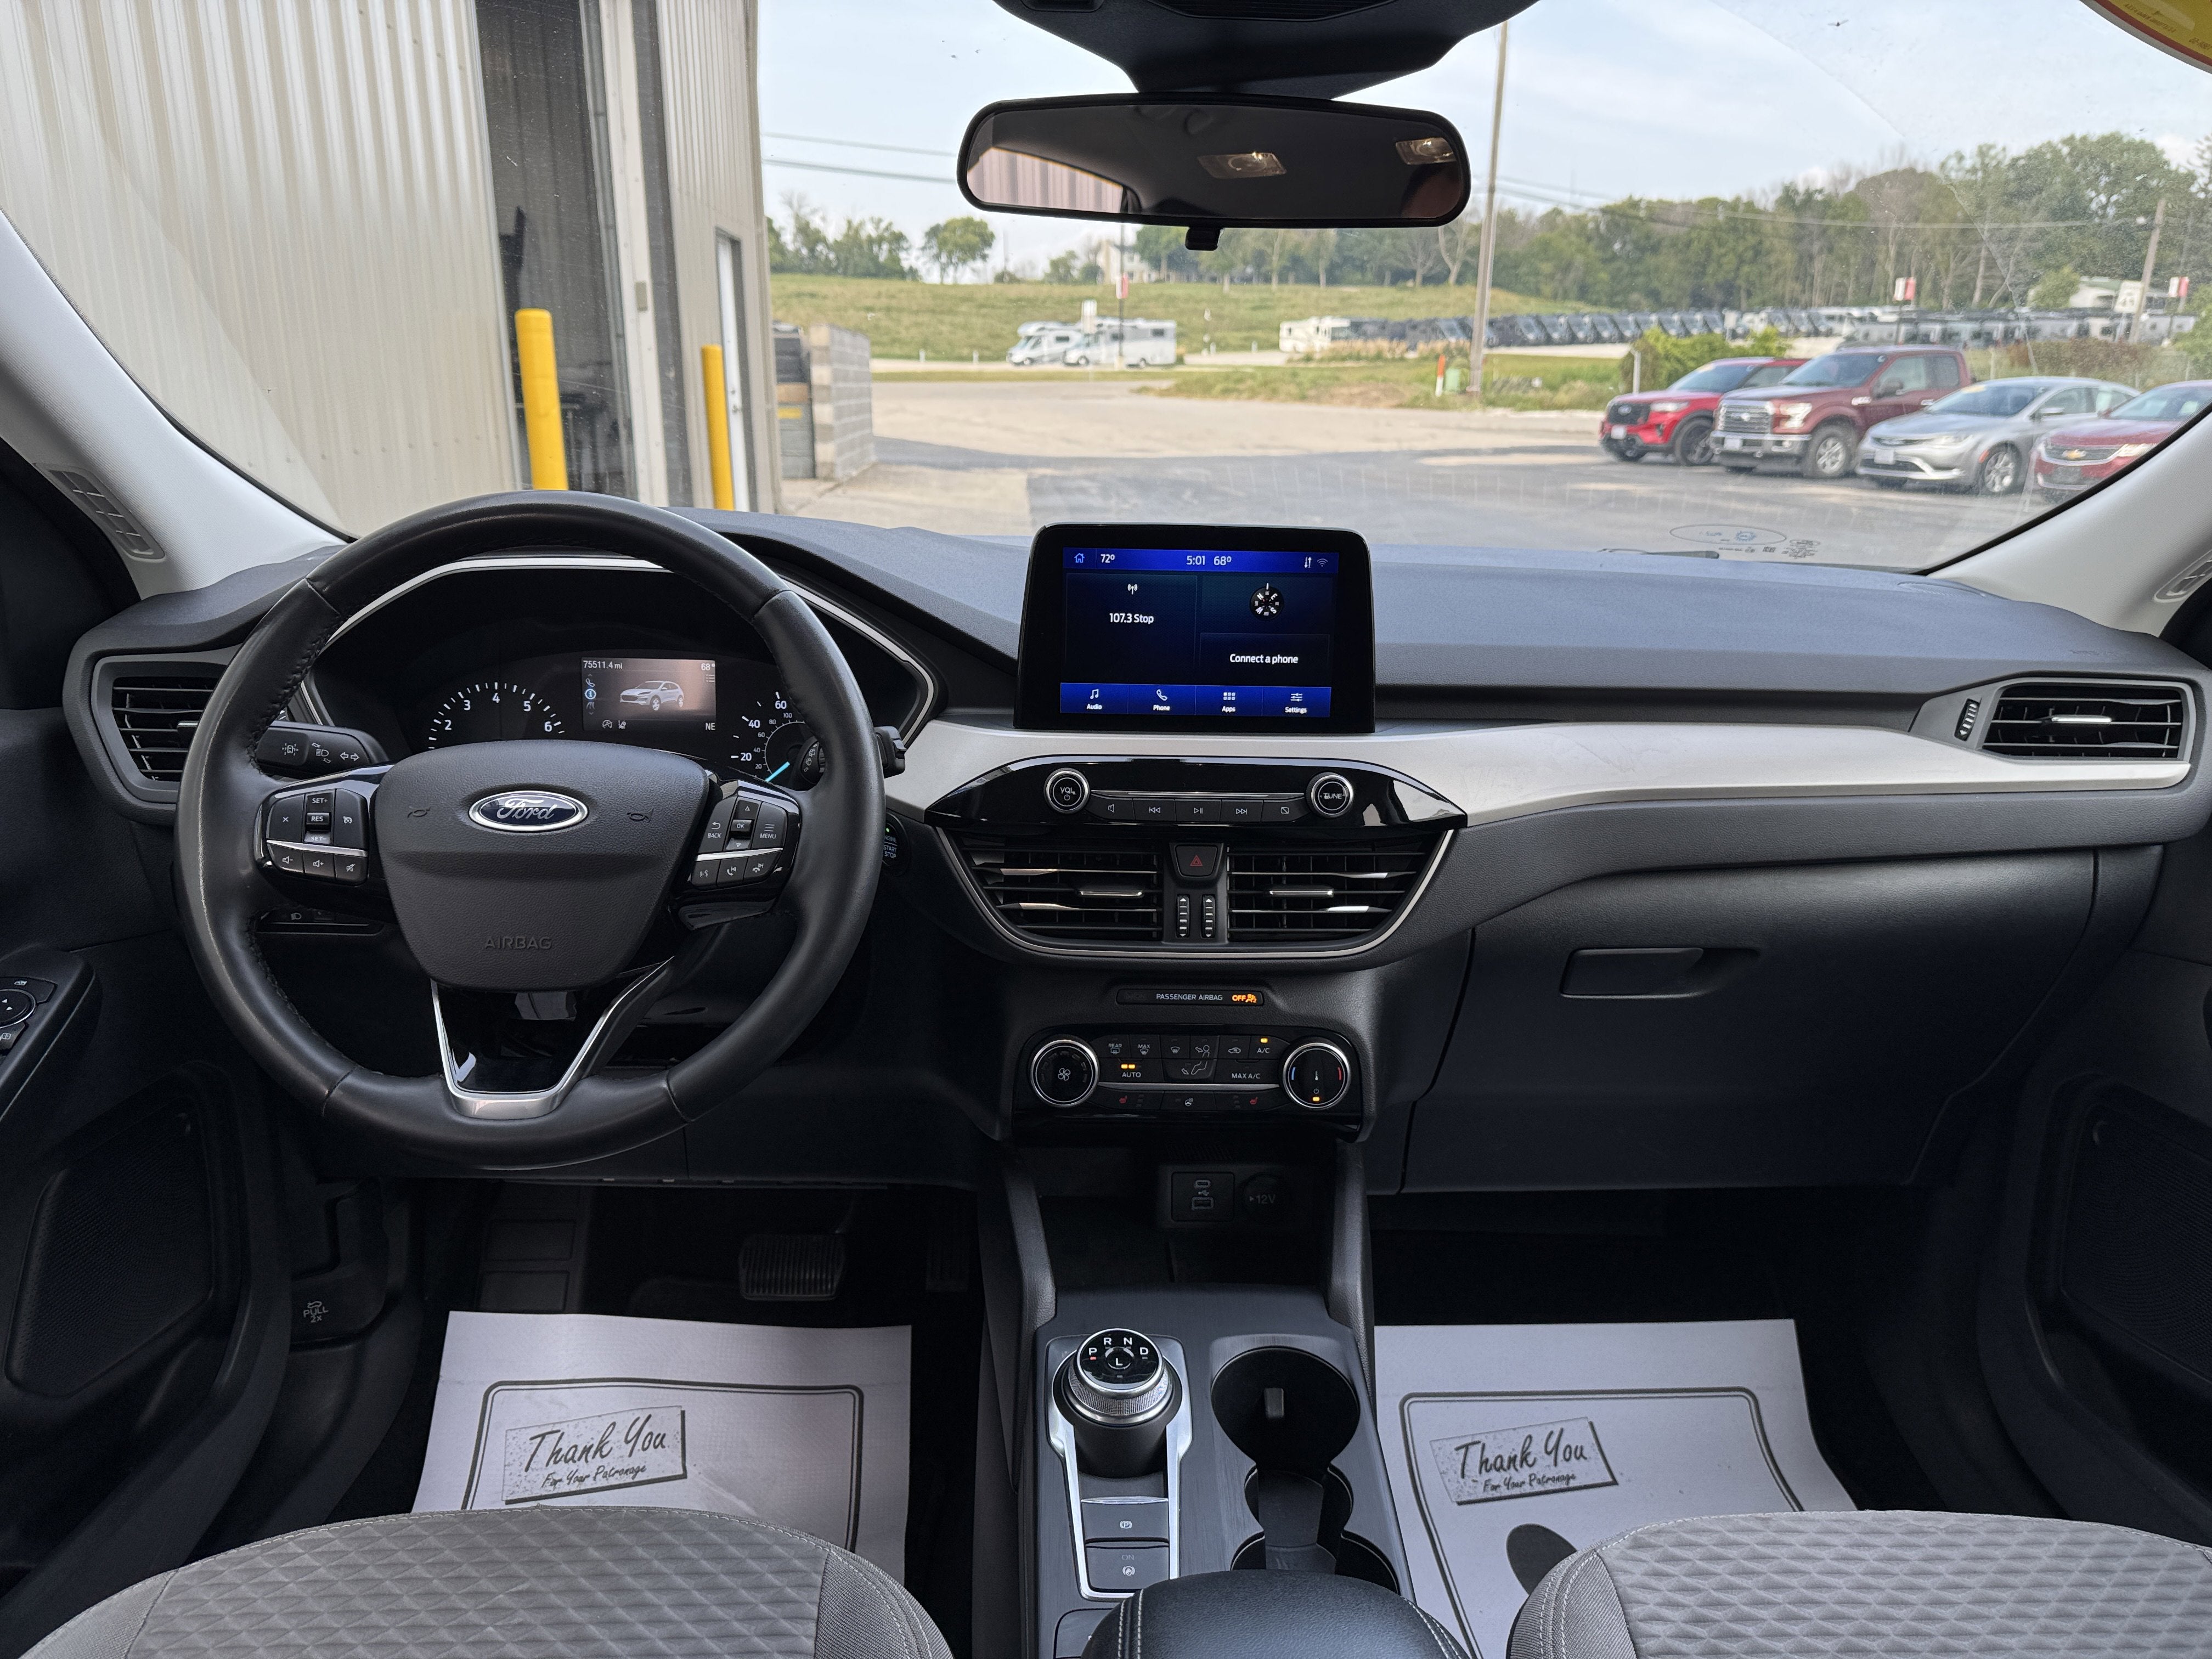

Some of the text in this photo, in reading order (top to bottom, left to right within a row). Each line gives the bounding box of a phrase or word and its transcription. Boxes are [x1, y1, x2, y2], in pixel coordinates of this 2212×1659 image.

[1186, 555, 1205, 566] 5:01
[1109, 613, 1154, 625] 107.3 Stop
[583, 660, 613, 669] 75511.4
[1229, 653, 1264, 664] Connect
[1272, 654, 1298, 665] phone
[492, 692, 500, 703] 4
[463, 699, 471, 710] 3
[523, 701, 531, 712] 5
[775, 700, 787, 709] 60
[1285, 706, 1307, 714] Settings
[444, 719, 452, 731] 2
[544, 721, 552, 732] 6
[705, 722, 715, 731] NE
[748, 719, 760, 729] 40
[741, 752, 752, 761] 20
[496, 798, 557, 820] Ford
[884, 850, 896, 859] STOP
[484, 935, 552, 950] AIRBAG
[1256, 1194, 1276, 1204] 12V
[303, 1306, 329, 1318] PULL
[1124, 1337, 1133, 1345] N
[1115, 1358, 1123, 1366] L
[524, 1414, 666, 1472] Thank You
[1454, 1427, 1588, 1479] Thank You
[541, 1465, 647, 1488] For Your Patronage
[1483, 1472, 1576, 1493] For Your Patronage
